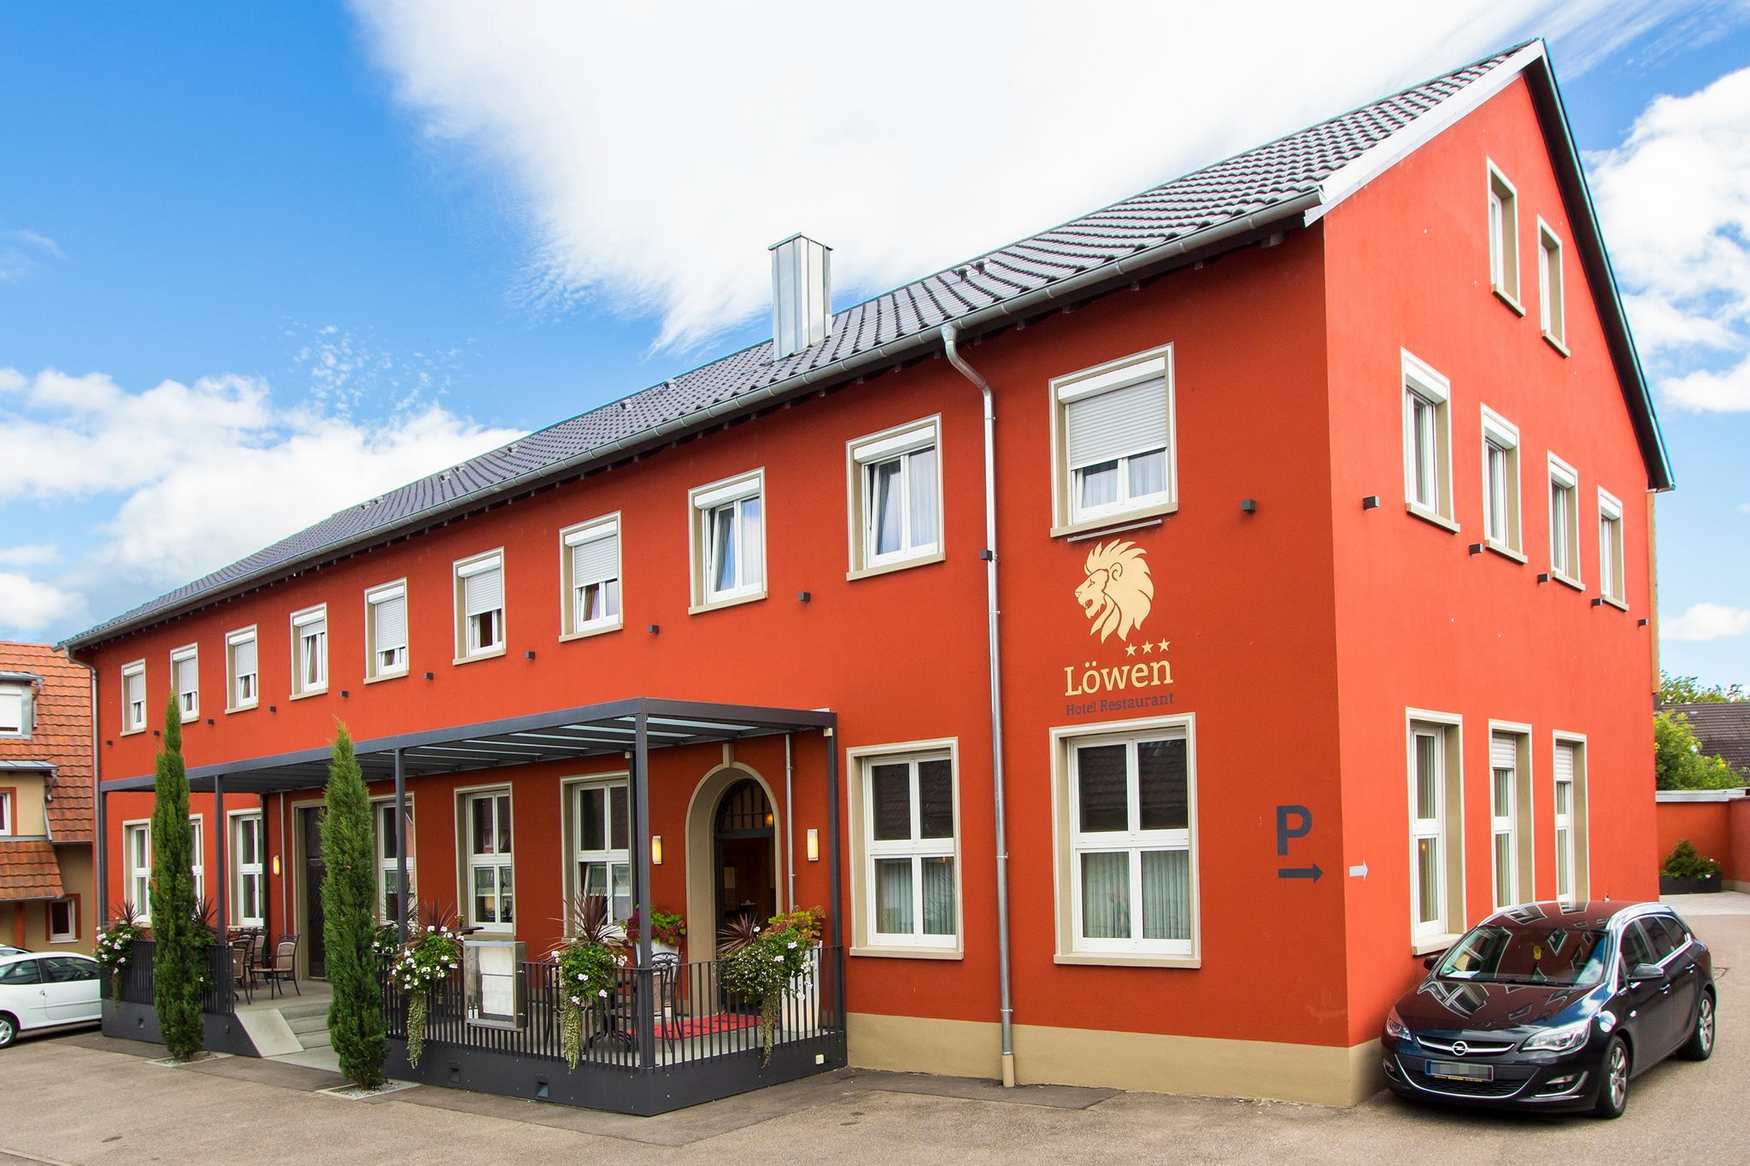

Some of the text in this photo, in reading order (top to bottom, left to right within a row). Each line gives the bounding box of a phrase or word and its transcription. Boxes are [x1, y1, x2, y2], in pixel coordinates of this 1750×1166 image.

[1064, 659, 1173, 696] Löwen
[1066, 693, 1174, 716] Hotel Restaurant
[1277, 805, 1312, 855] P
